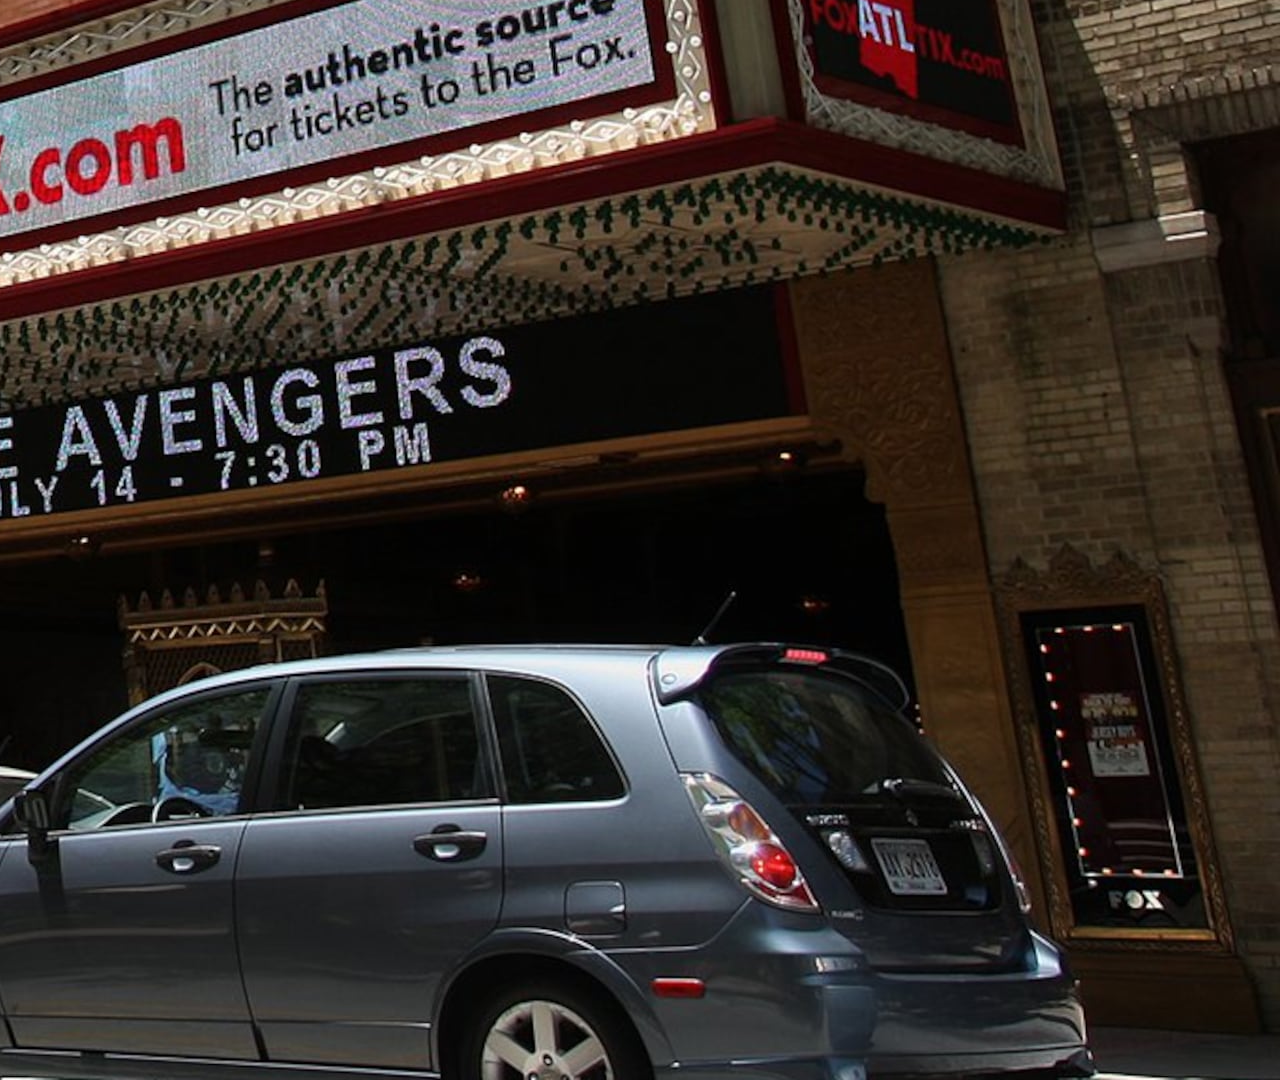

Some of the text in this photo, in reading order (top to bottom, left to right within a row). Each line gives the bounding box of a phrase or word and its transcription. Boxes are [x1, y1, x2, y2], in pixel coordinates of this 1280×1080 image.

[209, 75, 274, 117] The
[283, 22, 465, 99] authentic
[229, 32, 637, 157] for tickets to the Fox.
[56, 335, 512, 473] AVENGERS
[90, 466, 137, 507] 14
[170, 476, 183, 488] -
[213, 438, 322, 490] 7:30
[357, 420, 433, 472] PM
[1108, 889, 1165, 910] FOX
